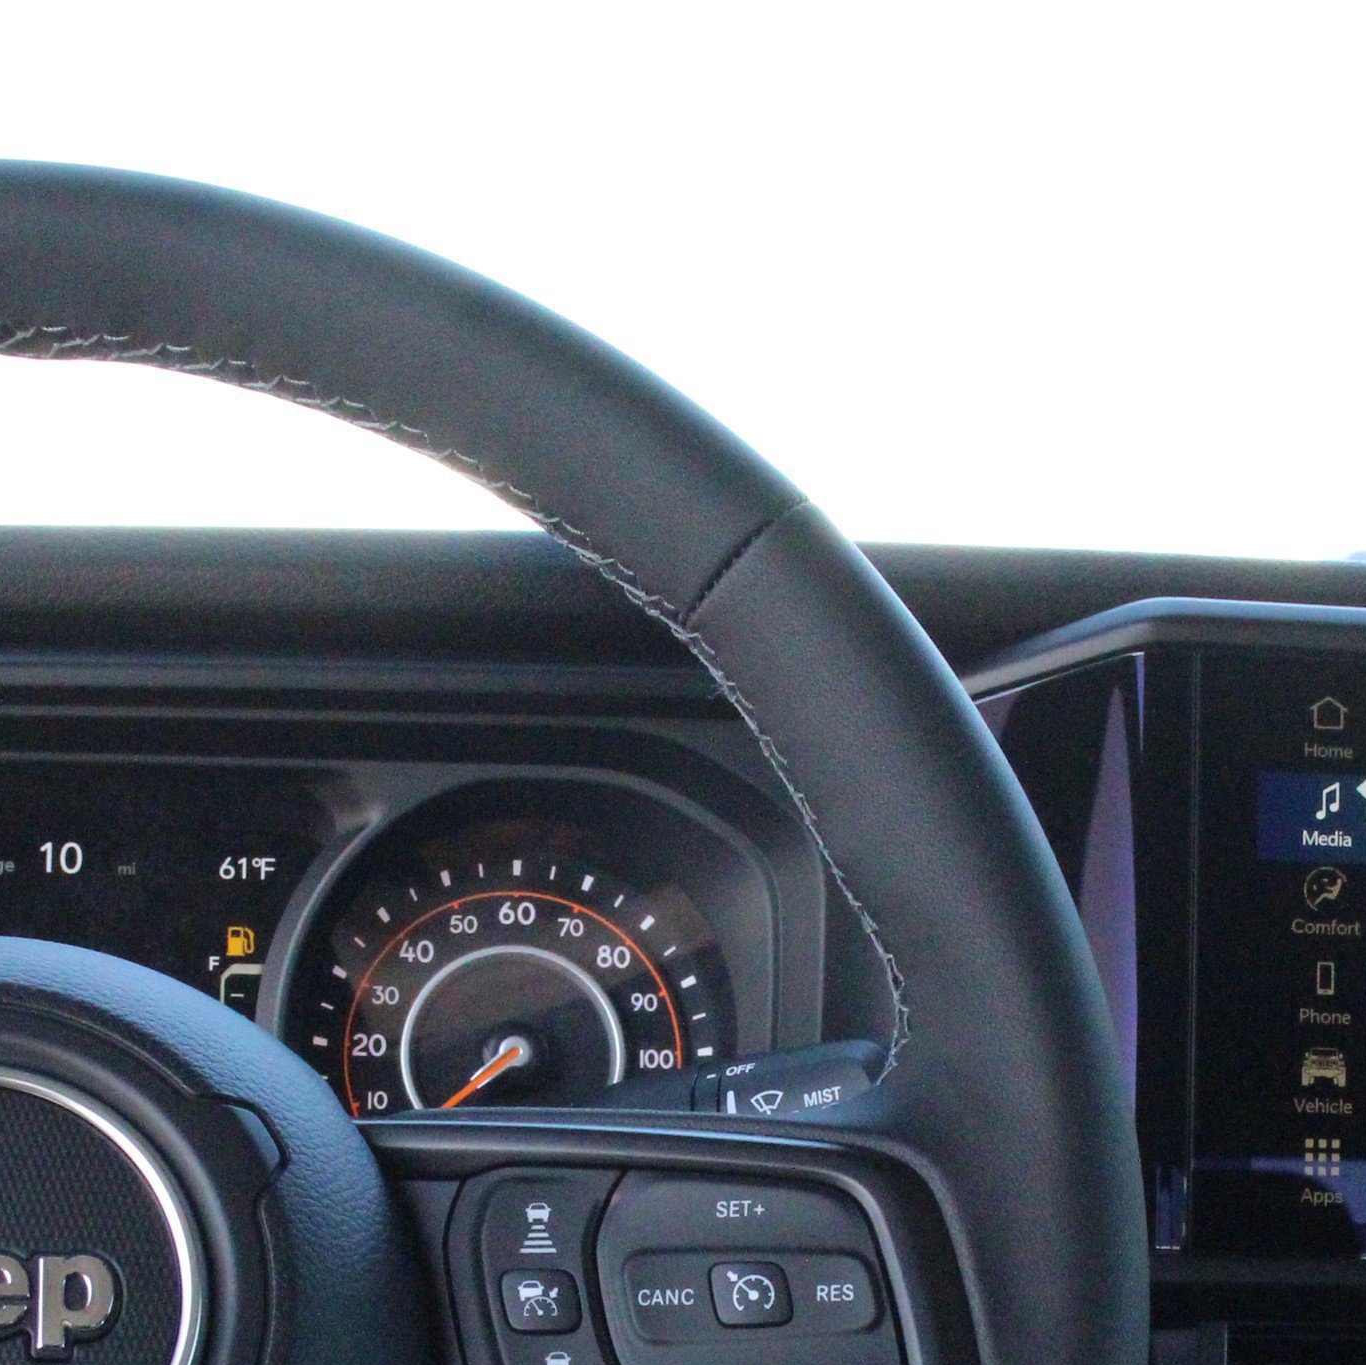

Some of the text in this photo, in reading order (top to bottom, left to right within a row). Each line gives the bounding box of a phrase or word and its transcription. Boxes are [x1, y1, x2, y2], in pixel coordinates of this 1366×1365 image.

[1304, 743, 1353, 760] Home
[1302, 830, 1352, 848] Media
[39, 842, 83, 874] 10
[218, 857, 276, 881] 61°F
[499, 903, 536, 926] 60
[449, 915, 478, 934] 50
[557, 917, 584, 937] 70
[1291, 918, 1361, 937] Comfort
[399, 940, 435, 963] 40
[597, 945, 631, 969] 80
[209, 955, 220, 971] F
[372, 985, 399, 1005] 30
[631, 993, 658, 1012] 90
[1299, 1007, 1351, 1026] Phone
[352, 1034, 387, 1057] 20
[639, 1049, 674, 1069] 100
[726, 1062, 755, 1077] OFF
[367, 1091, 388, 1110] 10
[804, 1086, 841, 1108] MIST
[1293, 1097, 1353, 1116] Vehicle
[1301, 1188, 1343, 1206] Apps
[638, 1289, 694, 1306] CANC
[816, 1285, 854, 1302] RES
